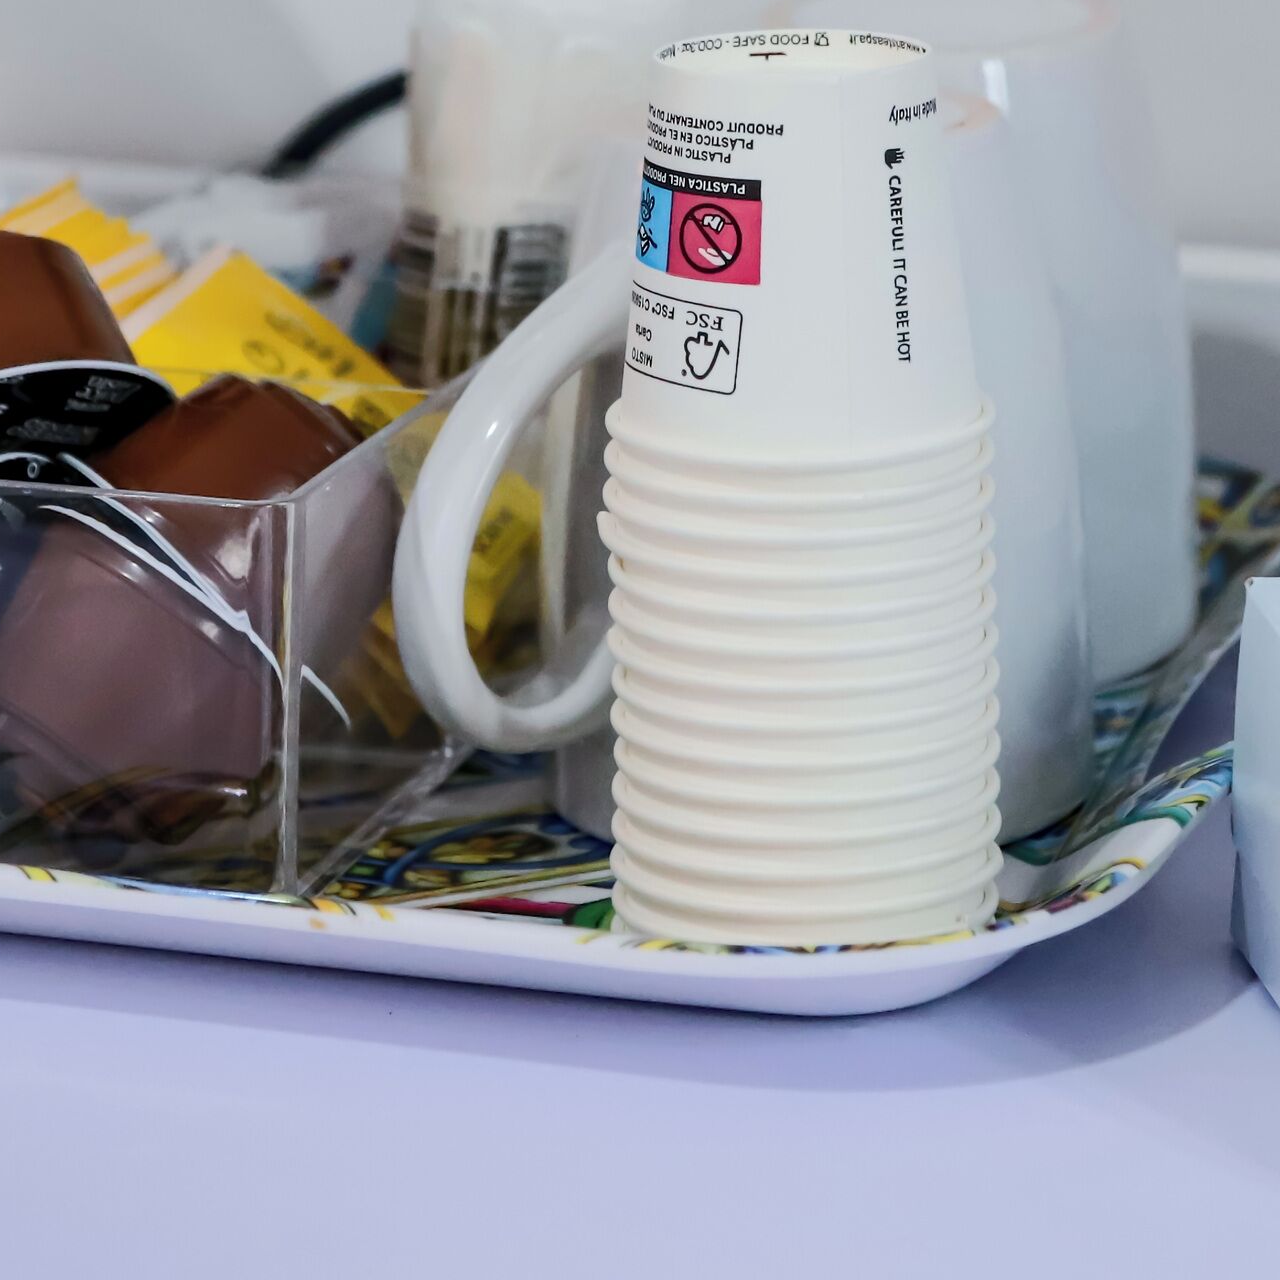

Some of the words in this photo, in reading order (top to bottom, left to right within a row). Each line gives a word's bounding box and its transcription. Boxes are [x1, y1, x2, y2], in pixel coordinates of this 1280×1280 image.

[732, 35, 766, 48] SAFE
[770, 33, 809, 46] FOOD
[889, 105, 912, 125] Italy
[913, 104, 921, 120] in
[665, 112, 724, 131] CONTENANT
[726, 122, 784, 136] PRODUIT
[669, 128, 678, 140] EL
[680, 131, 693, 143] EN
[695, 134, 754, 151] PLÁSTICO
[674, 146, 683, 157] IN
[685, 148, 731, 164] PLASTIC
[669, 173, 686, 188] NEL
[688, 178, 746, 195] PLASTICA
[888, 175, 904, 251] CAREFUL!
[893, 258, 906, 271] IT
[894, 274, 908, 307] CAN
[685, 310, 724, 331] FSC
[896, 310, 909, 329] BE
[635, 324, 652, 342] Carta
[897, 331, 911, 363] HOT
[631, 347, 653, 368] MISTO
